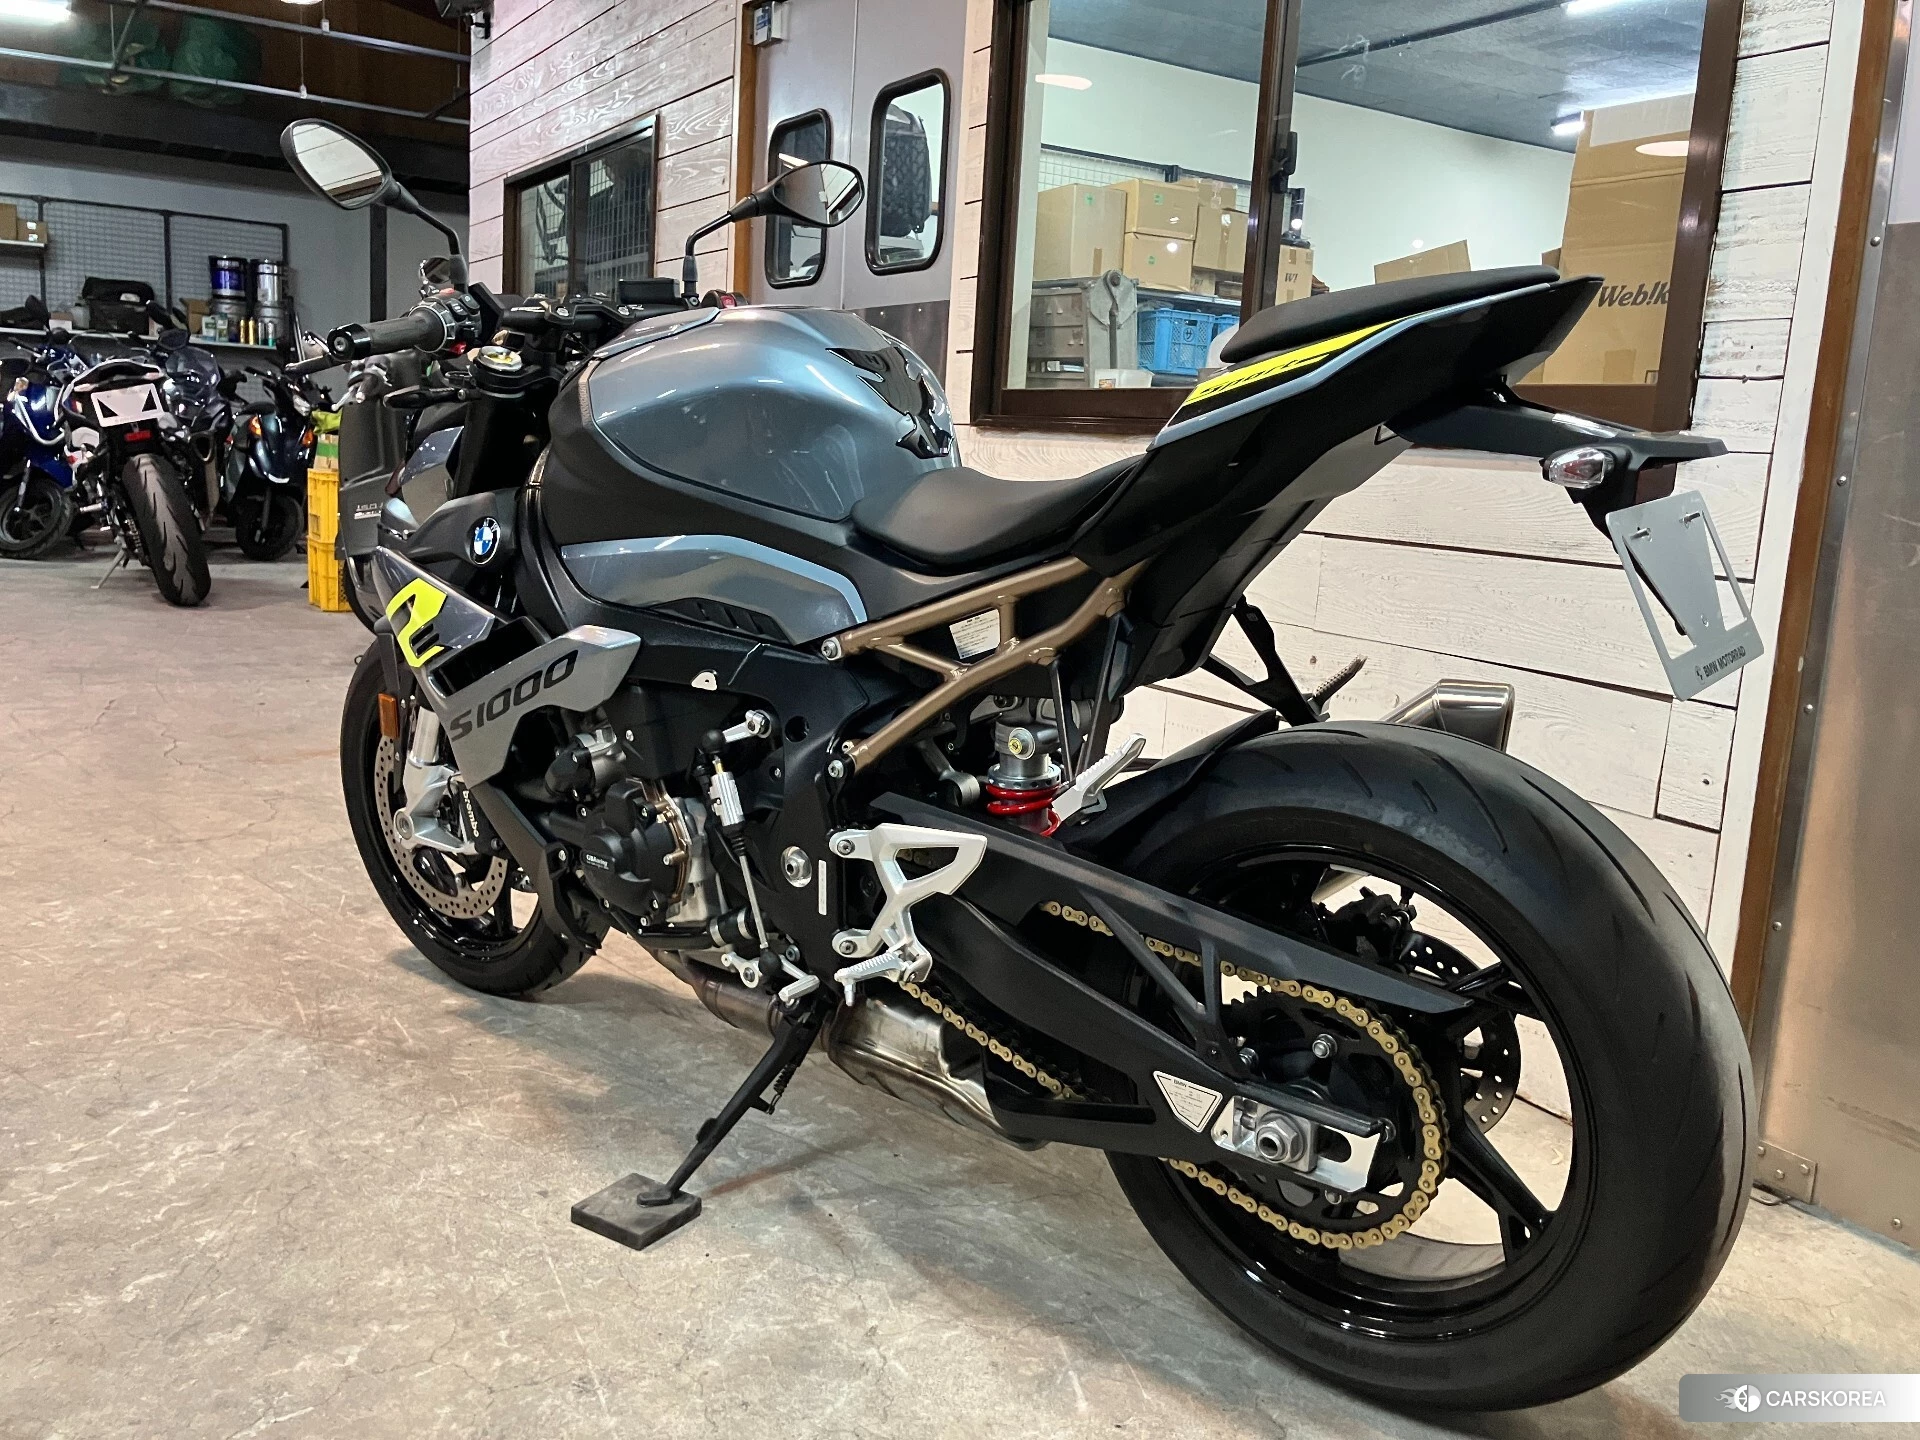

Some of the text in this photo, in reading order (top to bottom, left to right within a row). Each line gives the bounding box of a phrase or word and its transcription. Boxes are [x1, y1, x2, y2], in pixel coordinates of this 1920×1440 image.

[1703, 645, 1746, 678] BMW MOTORRAD
[462, 790, 480, 838] brembo
[1173, 1080, 1187, 1088] BMW
